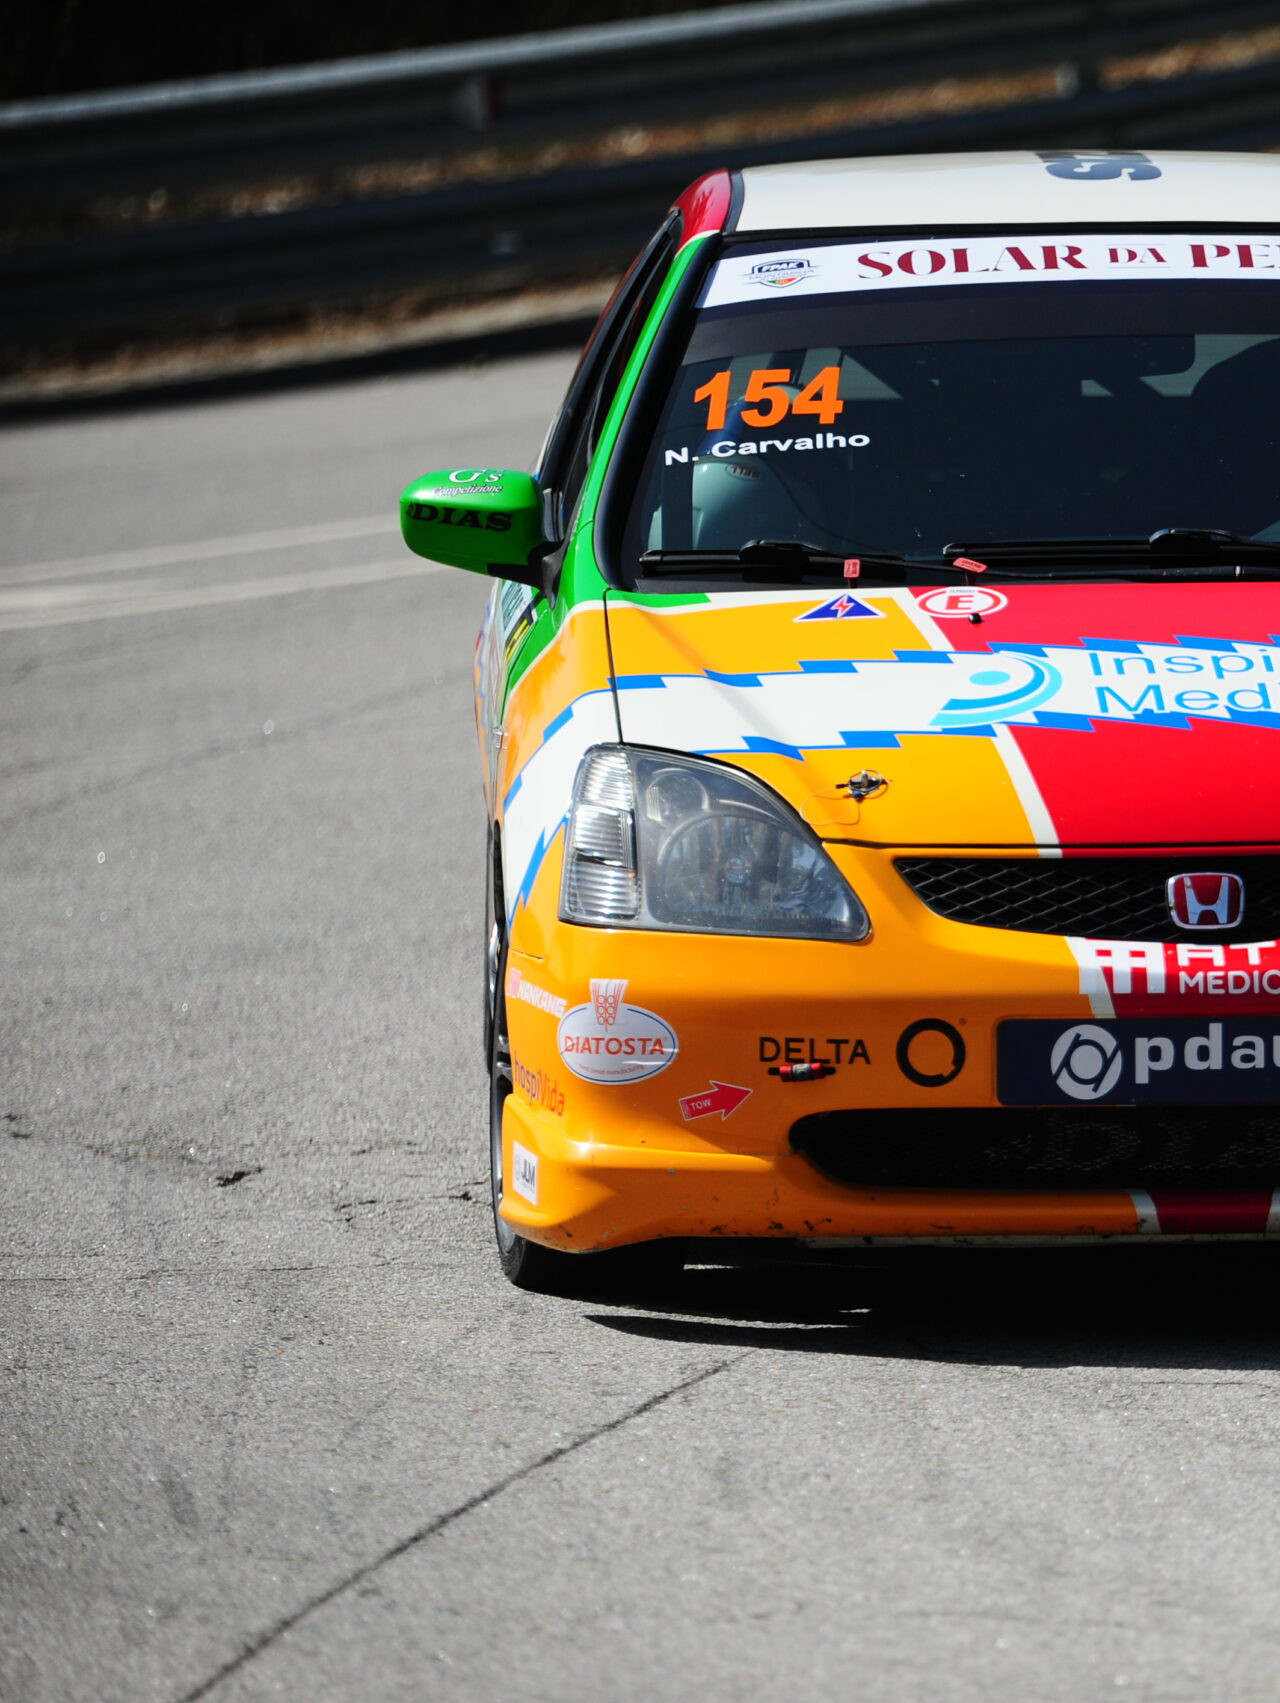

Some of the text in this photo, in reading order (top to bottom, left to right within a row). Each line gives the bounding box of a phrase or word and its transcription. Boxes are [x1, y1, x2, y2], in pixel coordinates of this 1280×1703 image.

[857, 245, 1088, 279] SOLAR
[1108, 248, 1167, 263] DA
[694, 366, 844, 431] 154
[665, 433, 870, 466] N. Carvalho
[412, 503, 513, 532] DIAS
[944, 594, 974, 611] E
[564, 1035, 665, 1056] DIATOSTA
[759, 1036, 871, 1065] DELTA
[514, 1050, 565, 1117] hospiVida
[690, 1098, 712, 1111] TOW
